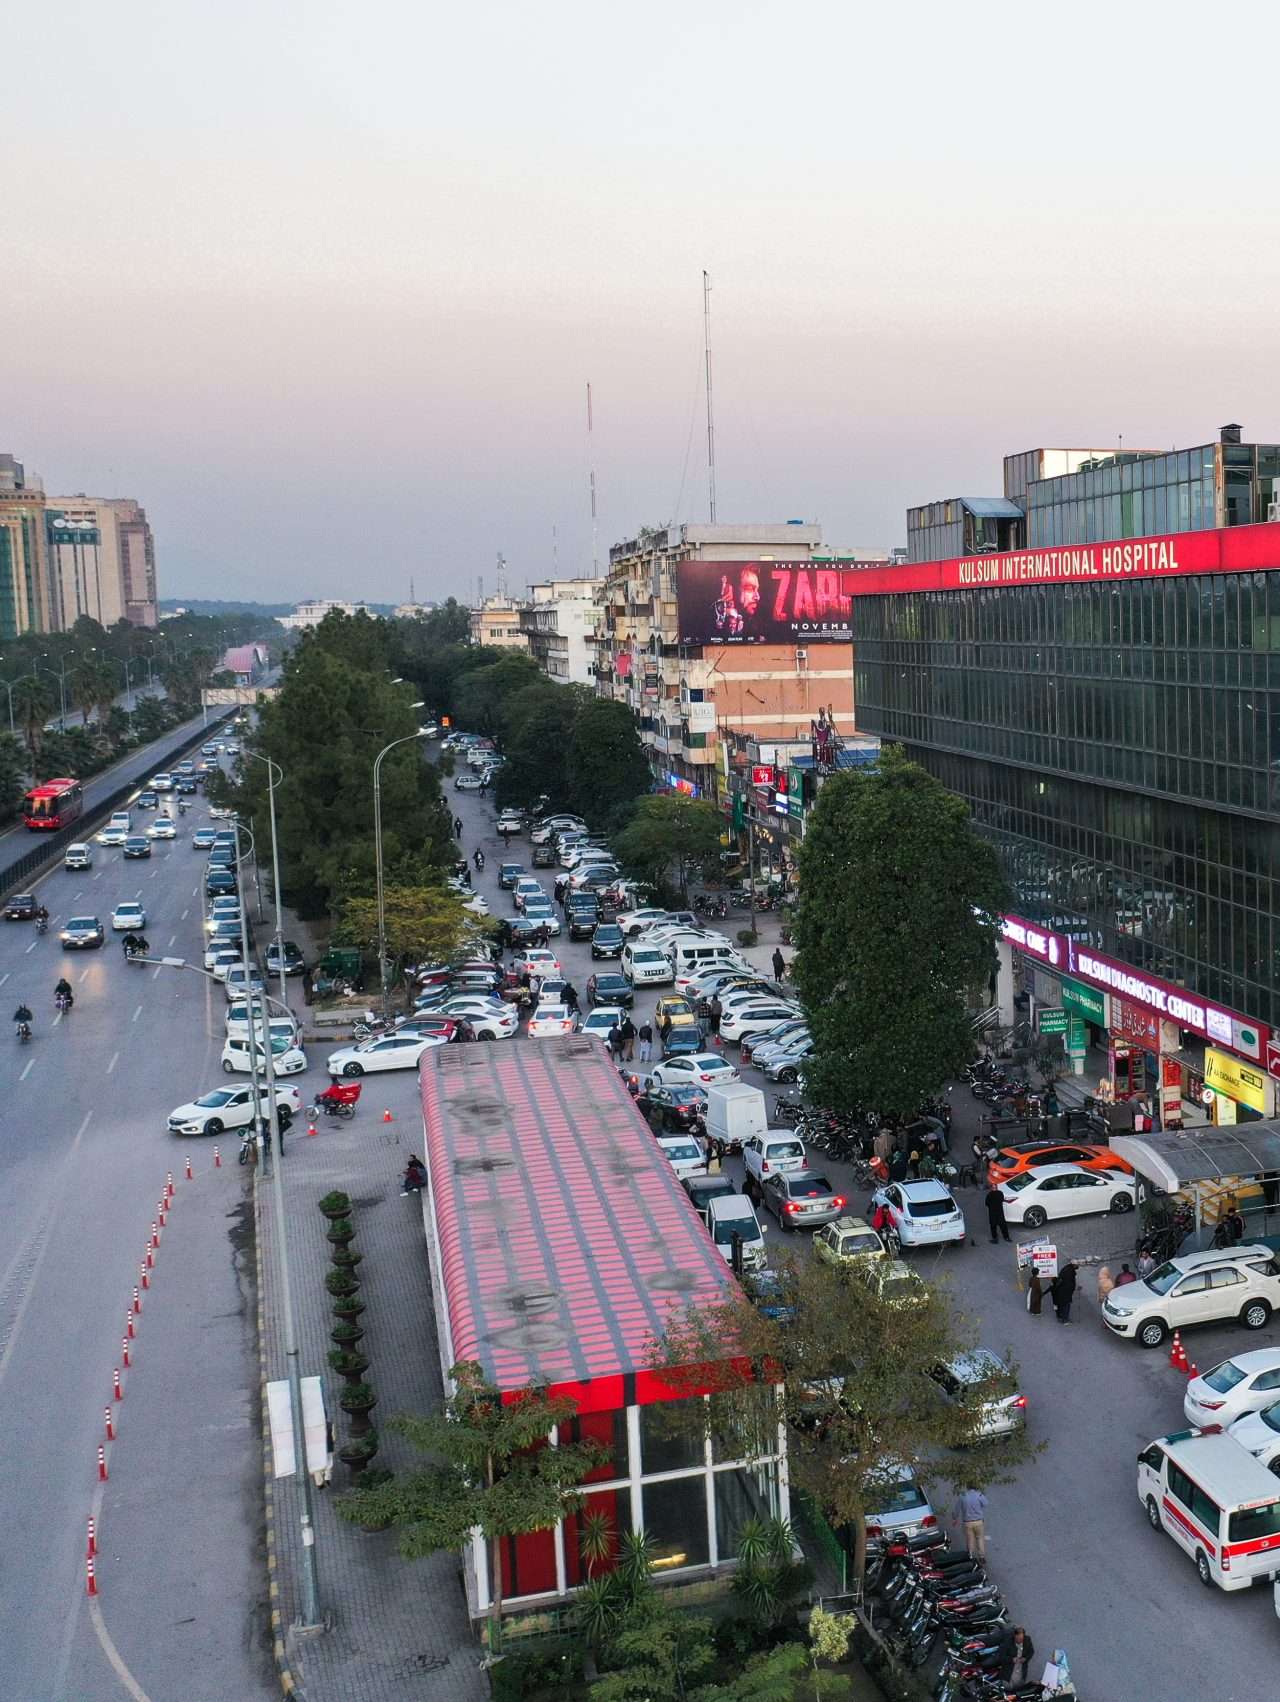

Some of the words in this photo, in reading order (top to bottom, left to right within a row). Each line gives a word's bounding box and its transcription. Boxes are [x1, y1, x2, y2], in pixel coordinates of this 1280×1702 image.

[959, 558, 999, 584] KULSUM
[1002, 549, 1098, 580] INTERNATIONAL
[1102, 540, 1179, 574] HOSPITAL
[1078, 953, 1111, 986] KULSUM
[1111, 968, 1168, 1012] DIAGNOSTIC
[1167, 995, 1206, 1030] CENTER
[1079, 994, 1103, 1014] PHARMACY
[1039, 1018, 1069, 1026] PHARMACY
